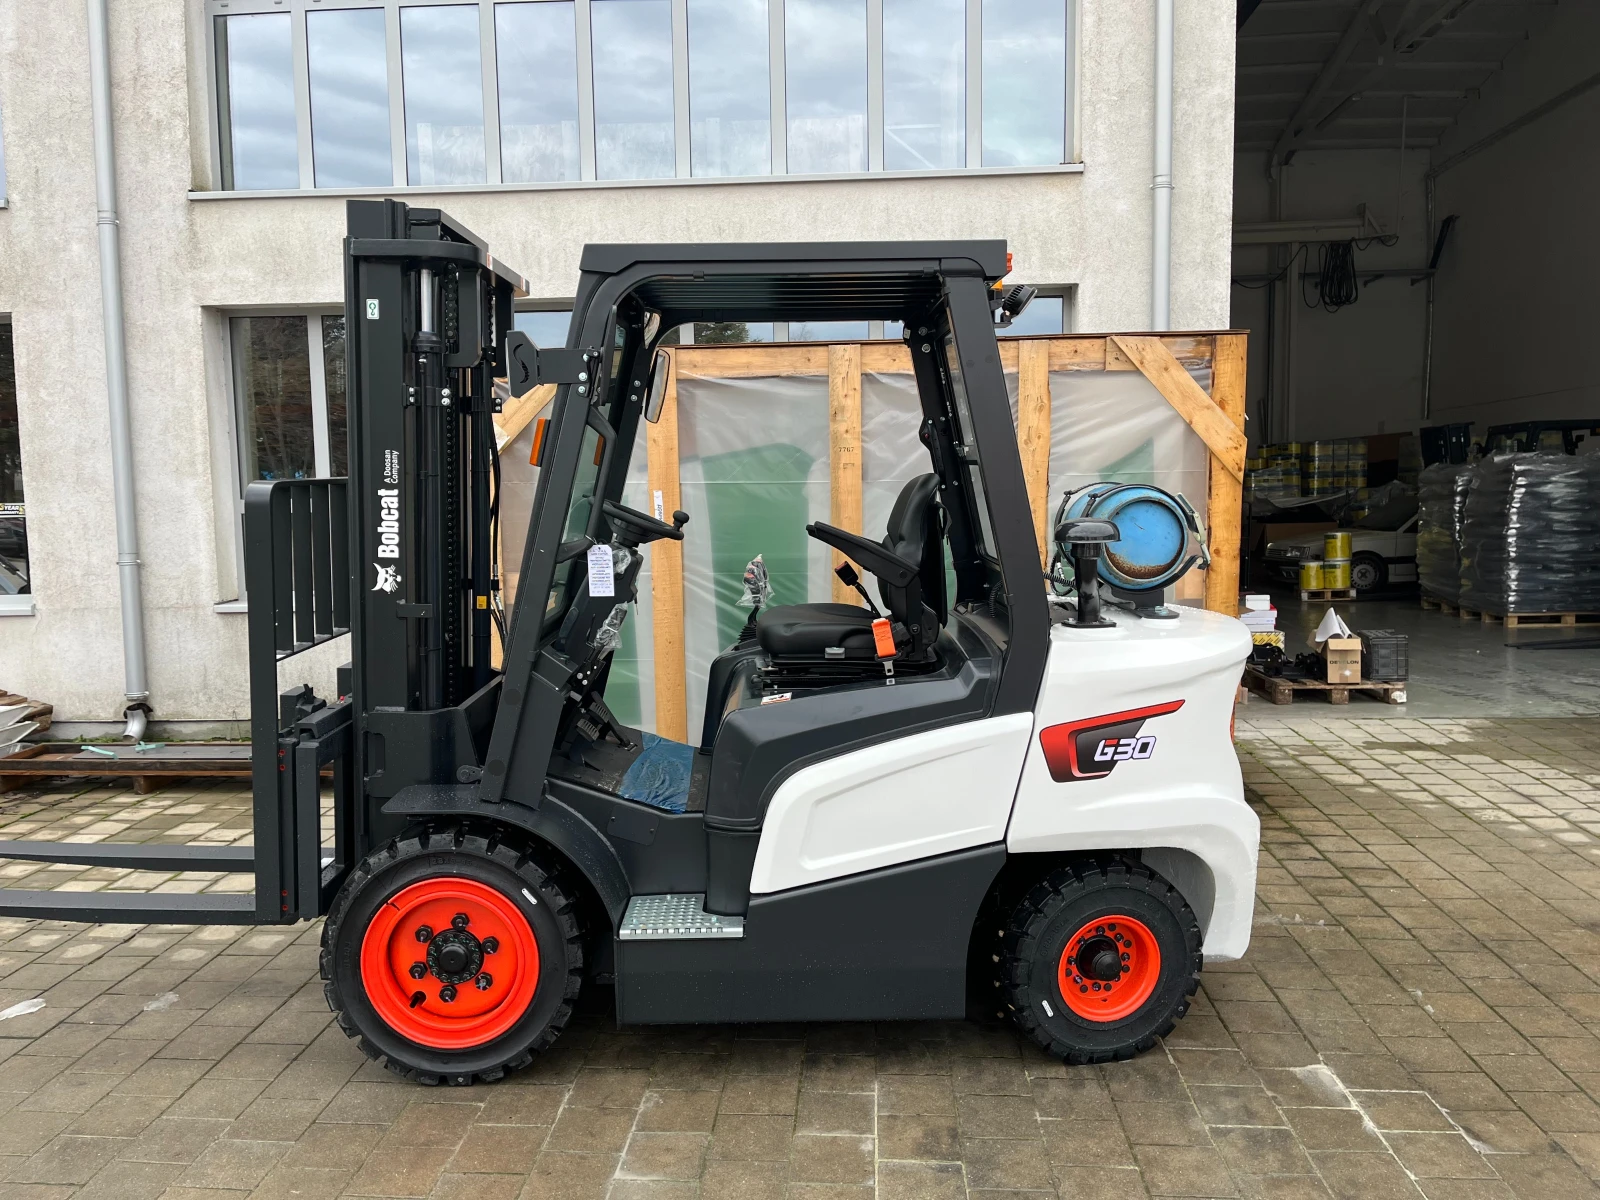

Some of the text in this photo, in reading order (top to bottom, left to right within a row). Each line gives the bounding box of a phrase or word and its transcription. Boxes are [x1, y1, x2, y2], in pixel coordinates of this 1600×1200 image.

[391, 450, 400, 484] Company
[377, 488, 400, 558] Bobcat
[1093, 735, 1157, 762] G30
